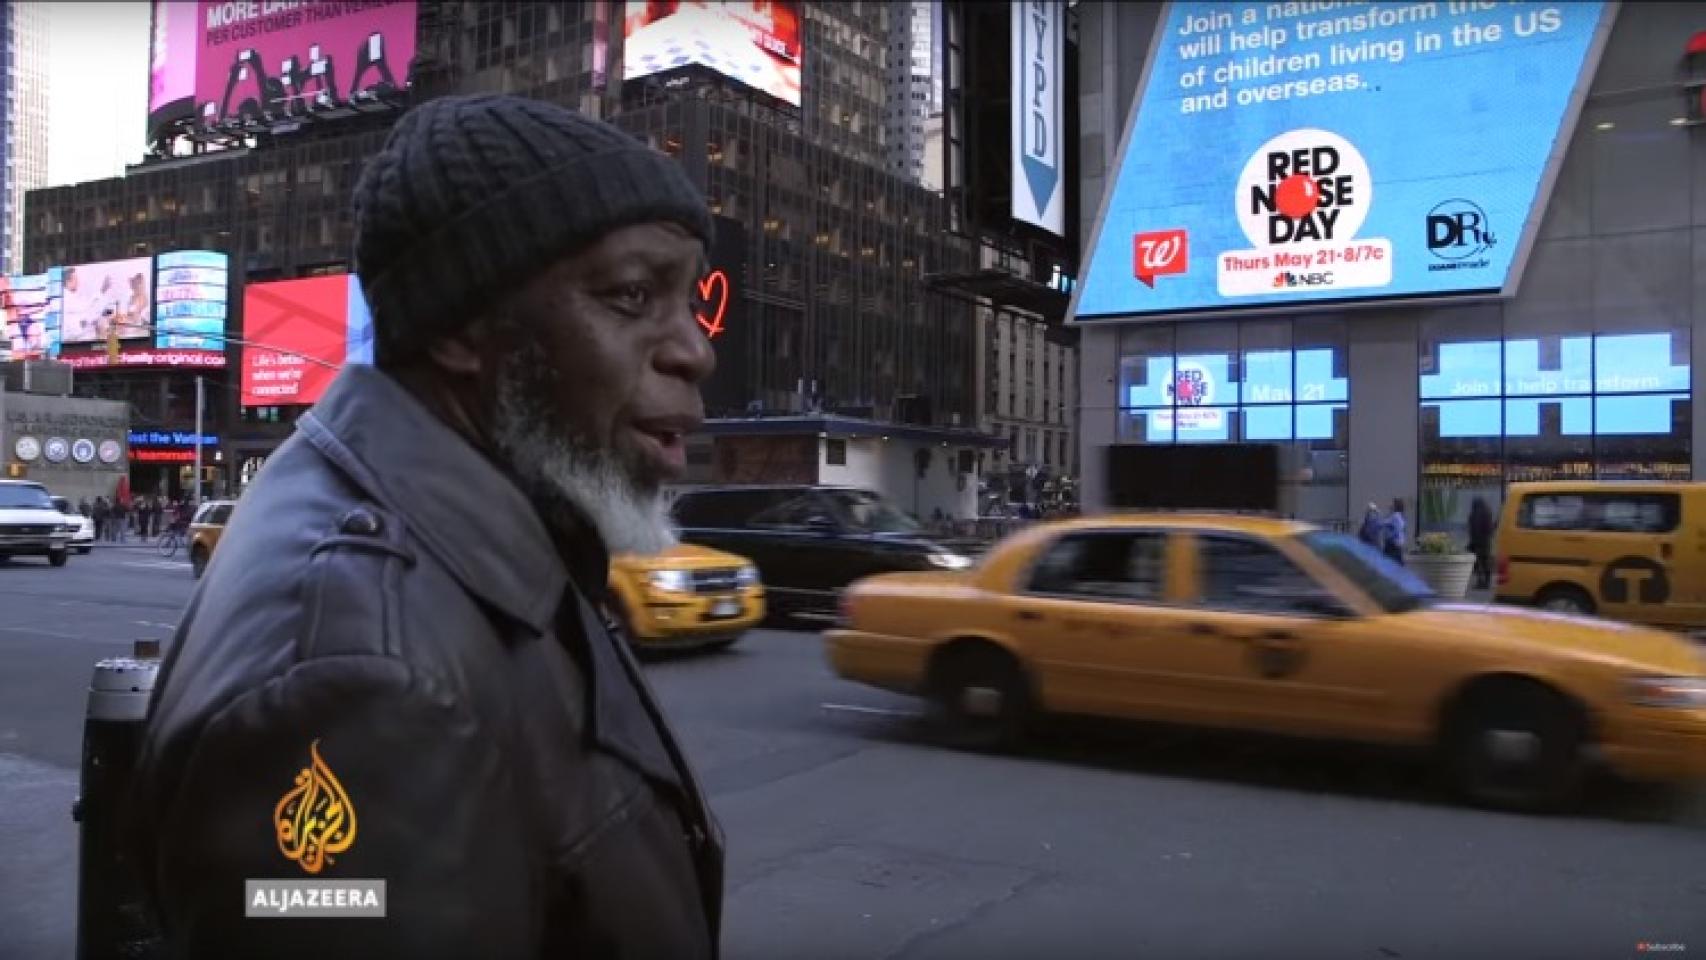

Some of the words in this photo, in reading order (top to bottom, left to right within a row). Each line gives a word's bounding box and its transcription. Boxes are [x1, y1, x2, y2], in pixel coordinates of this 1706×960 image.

[206, 2, 258, 29] MORE
[231, 10, 301, 42] CUSTOMER
[1179, 10, 1233, 36] Join
[1242, 8, 1257, 26] a
[1179, 33, 1221, 60] will
[1230, 25, 1286, 51] help
[1296, 3, 1438, 41] transform
[1180, 66, 1205, 88] of
[1213, 51, 1321, 84] children
[1330, 40, 1405, 65] living
[1415, 29, 1441, 54] in
[1452, 22, 1501, 47] the
[1514, 8, 1562, 37] US
[1032, 2, 1047, 158] YPD
[1180, 88, 1228, 114] and
[1236, 72, 1368, 106] overseas.
[1267, 146, 1340, 182] RED
[1268, 208, 1340, 245] DAY
[1223, 256, 1270, 272] Thurs
[1274, 251, 1313, 269] May
[1300, 271, 1334, 286] NBC
[1303, 383, 1324, 400] 21
[1453, 379, 1489, 394] Join
[1519, 378, 1558, 394] help
[1614, 567, 1655, 605] T
